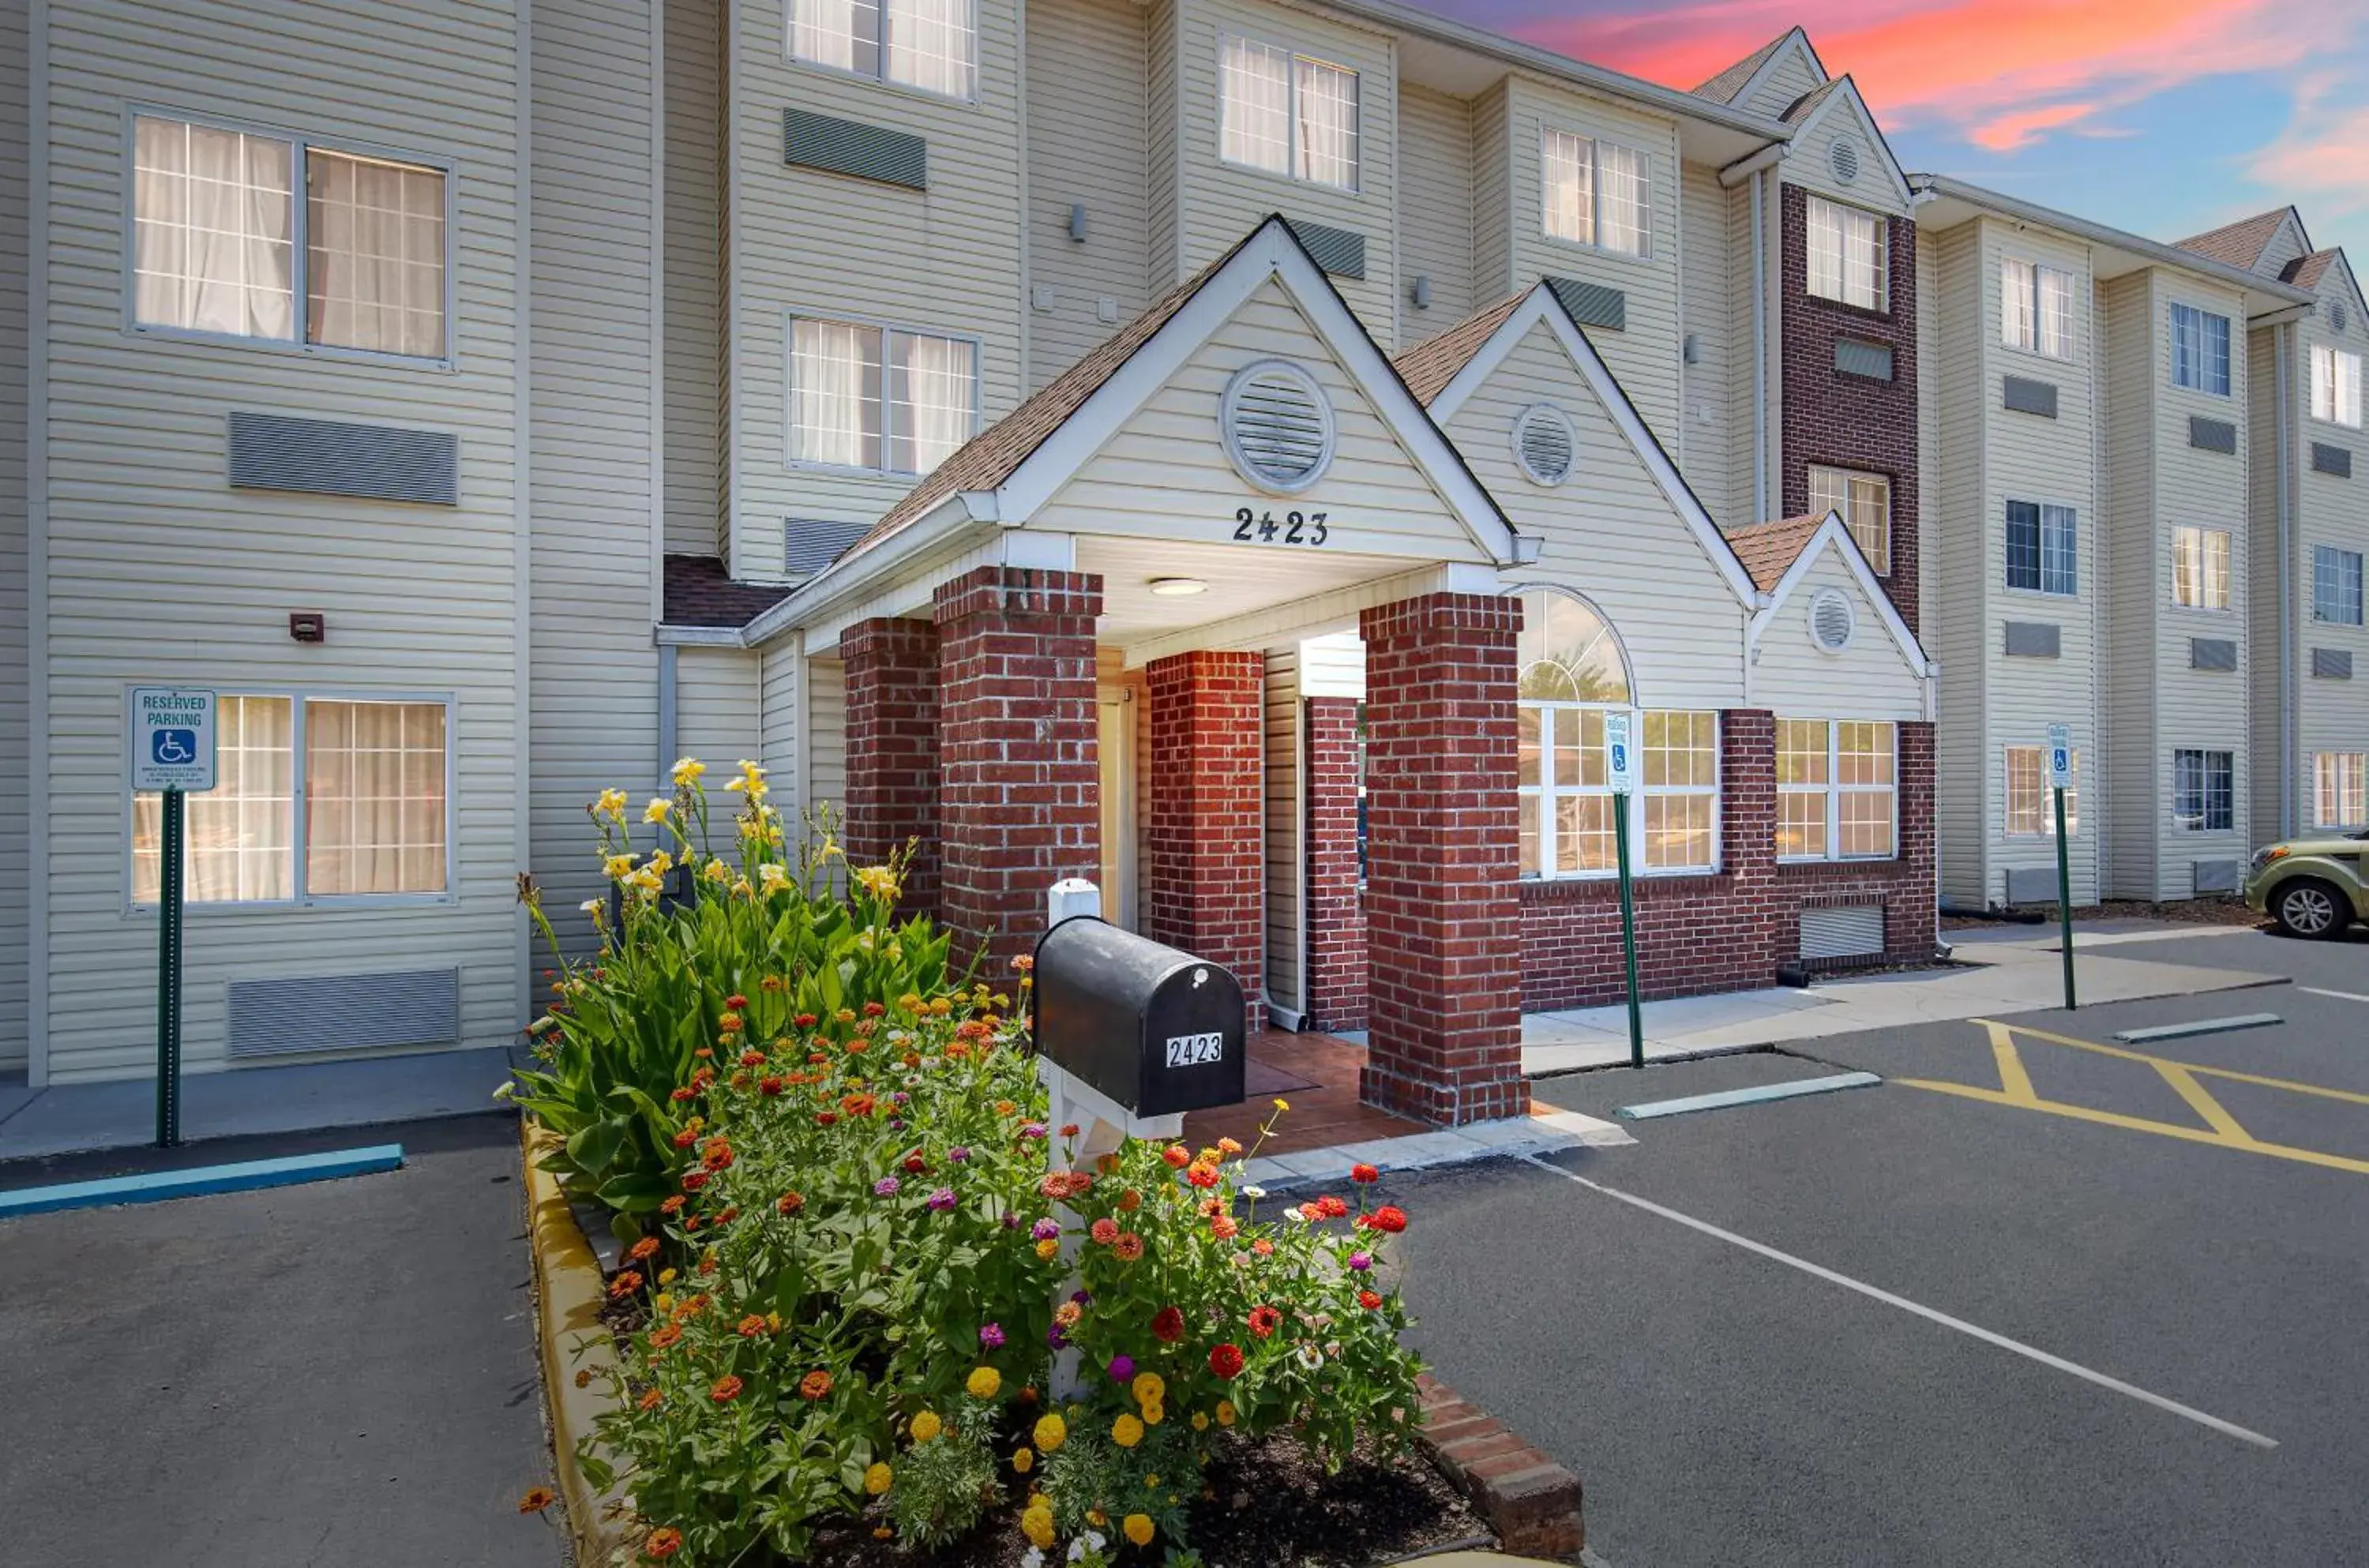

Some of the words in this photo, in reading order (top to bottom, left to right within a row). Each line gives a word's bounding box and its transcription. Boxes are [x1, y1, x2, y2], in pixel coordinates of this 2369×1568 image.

[1233, 508, 1327, 545] 2423
[143, 696, 206, 710] RESERVED
[148, 713, 201, 726] PARKING
[1169, 1036, 1220, 1067] 2423
